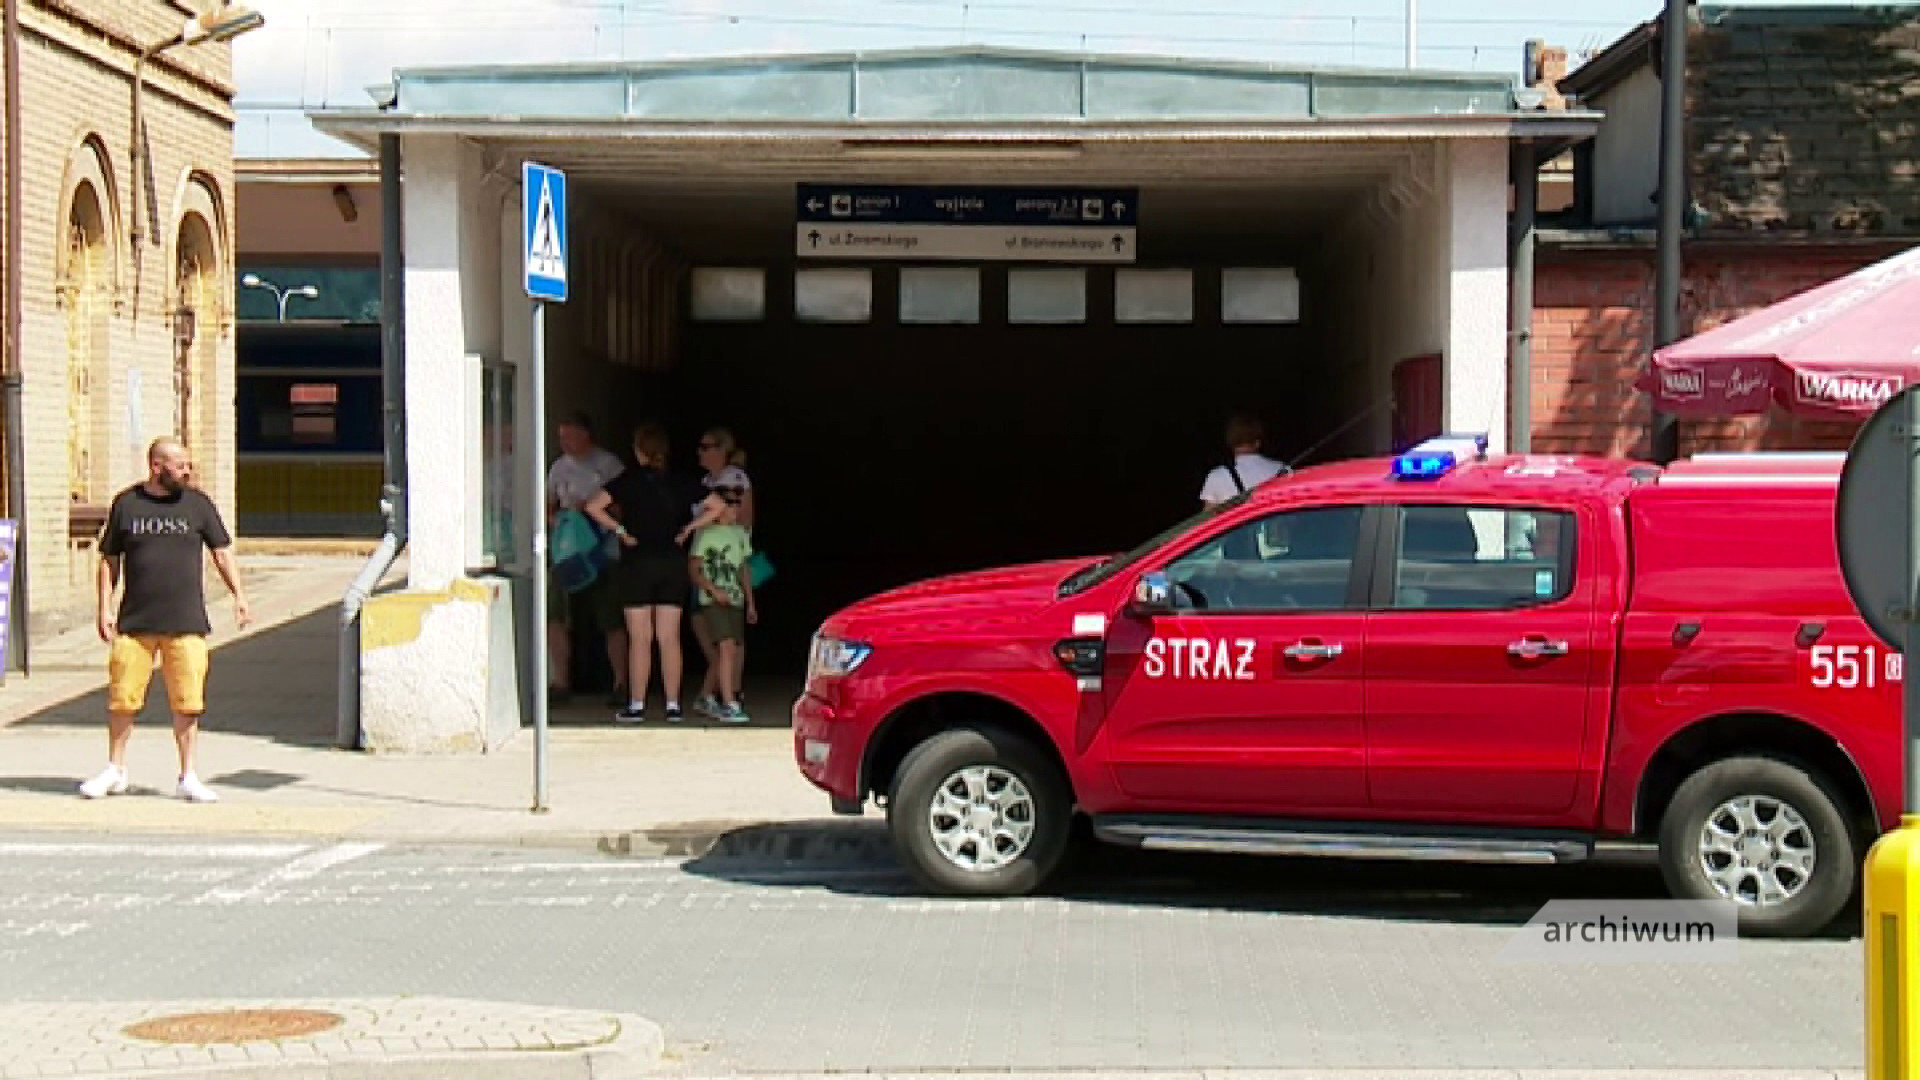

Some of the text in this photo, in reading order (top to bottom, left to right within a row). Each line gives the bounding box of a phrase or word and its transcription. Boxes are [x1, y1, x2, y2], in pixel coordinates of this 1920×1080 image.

[1801, 374, 1892, 399] WARKA
[132, 517, 189, 535] BOSS
[1810, 645, 1875, 689] 551
